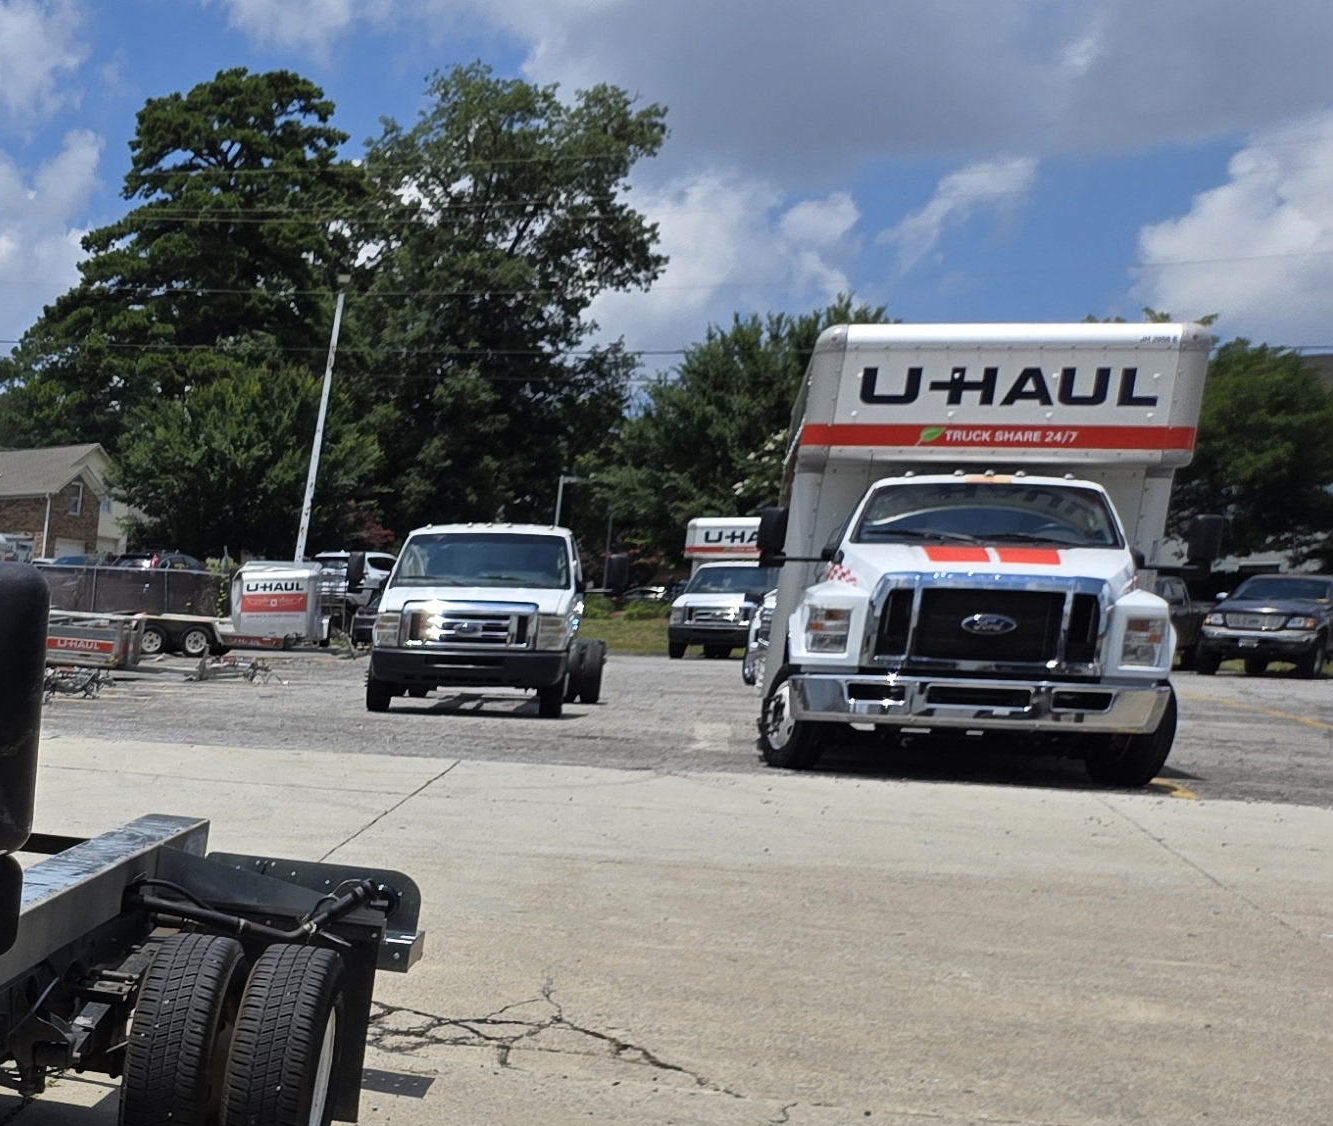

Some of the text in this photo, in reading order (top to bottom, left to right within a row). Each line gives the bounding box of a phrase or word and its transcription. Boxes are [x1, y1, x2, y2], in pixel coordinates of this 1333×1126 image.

[859, 366, 1159, 407] U-HAUL
[945, 430, 1078, 444] TRUCK SHARE 24/7
[704, 530, 759, 544] U-HA
[246, 582, 305, 592] U-HAUL
